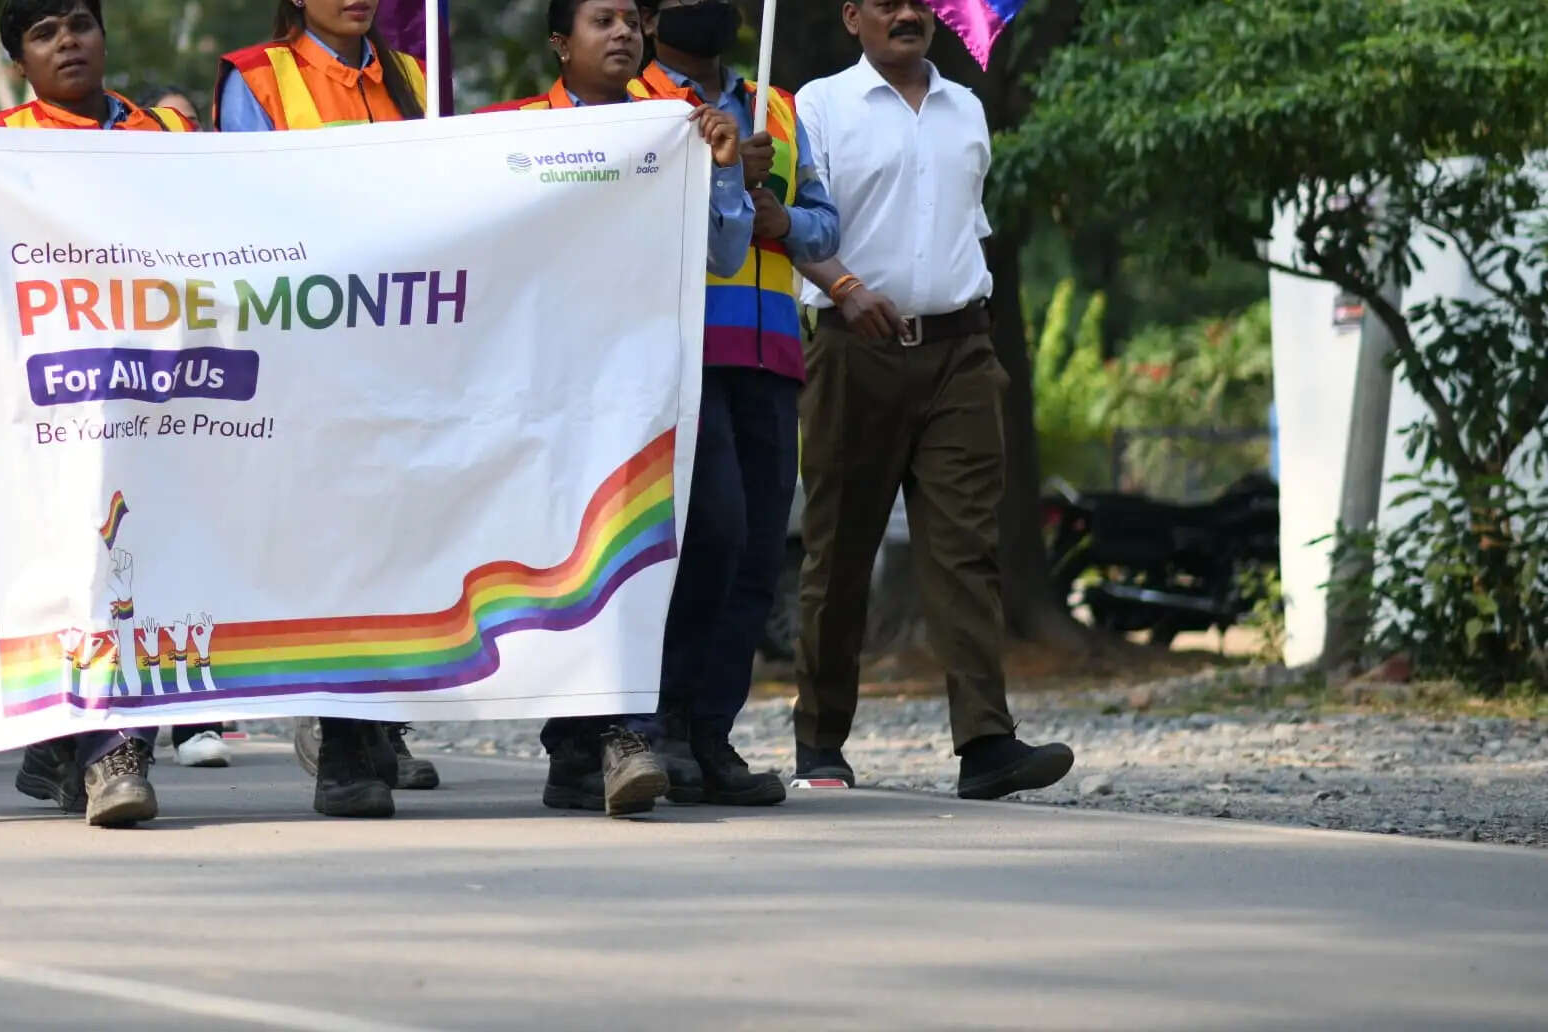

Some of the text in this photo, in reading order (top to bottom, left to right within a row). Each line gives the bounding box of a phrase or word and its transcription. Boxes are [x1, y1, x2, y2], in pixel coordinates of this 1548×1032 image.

[534, 149, 606, 166] vedanta
[539, 165, 620, 183] aluminium
[11, 241, 308, 268] Celebrating International
[15, 269, 468, 337] PRIDE MONTH
[43, 358, 225, 396] For All of Us
[36, 413, 275, 445] Be Yourself, Be Proud!
